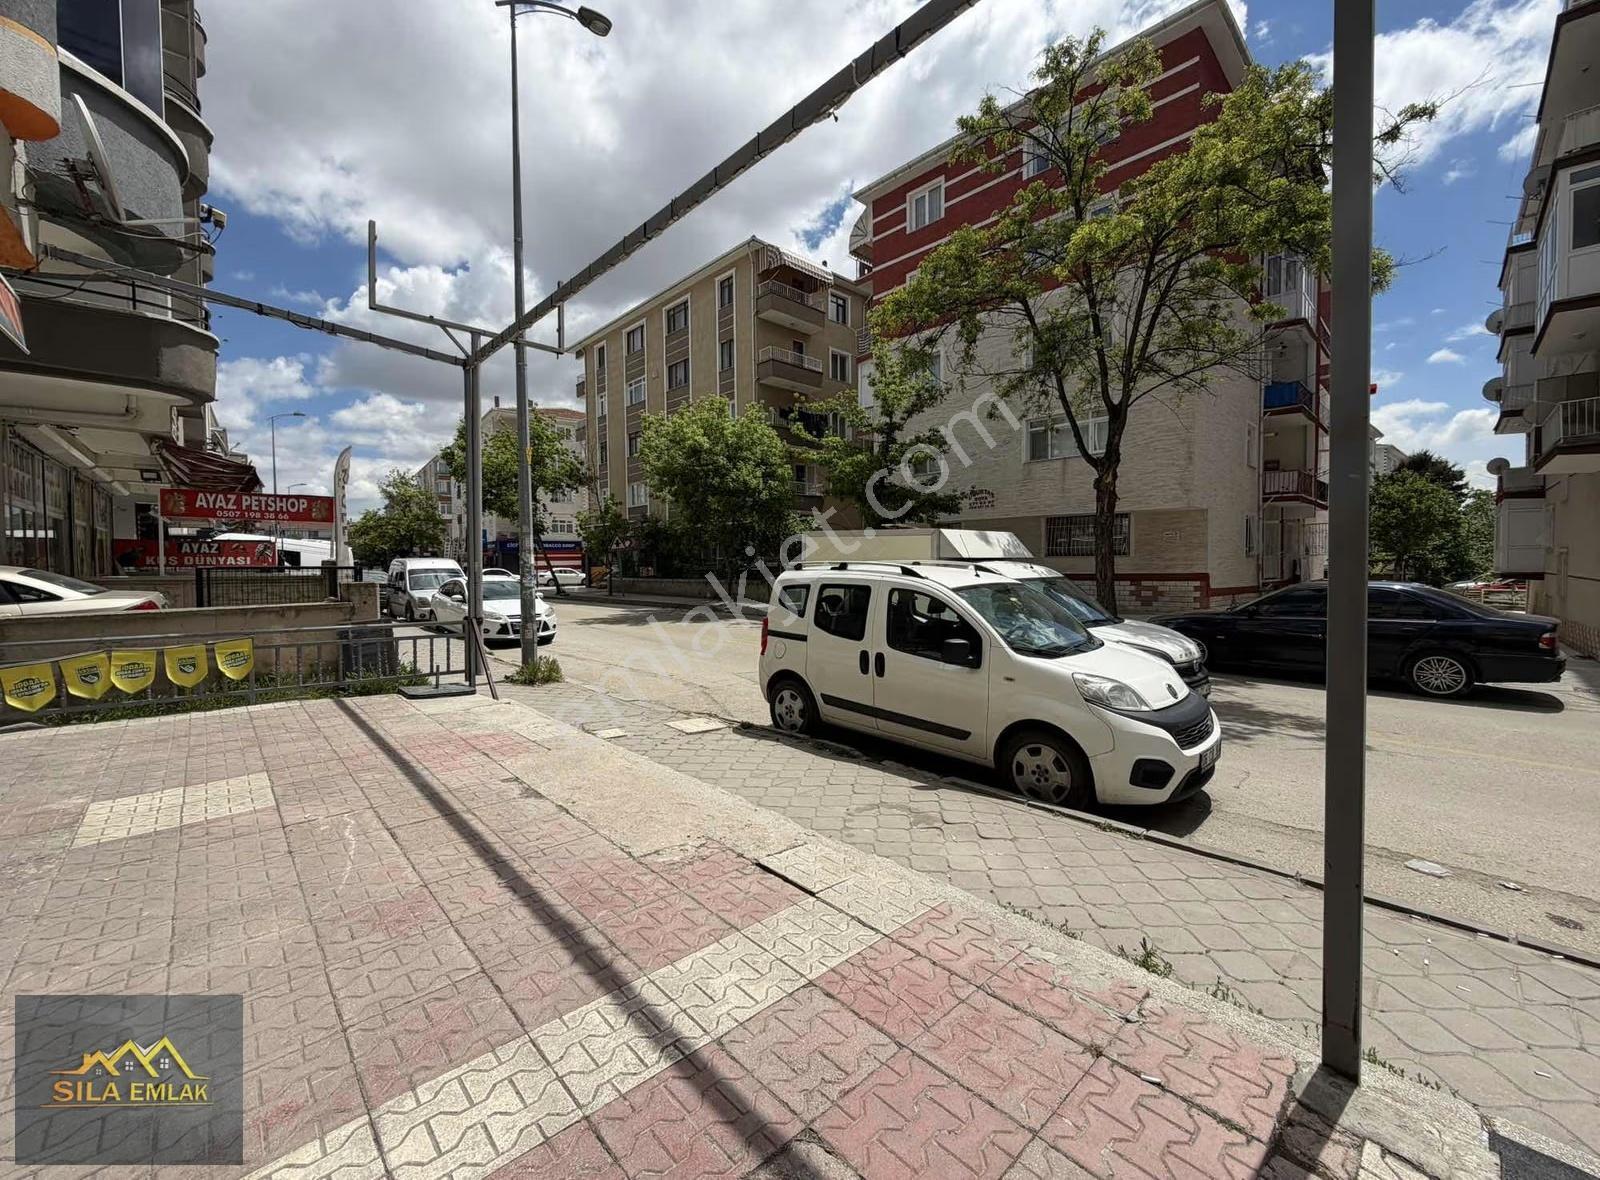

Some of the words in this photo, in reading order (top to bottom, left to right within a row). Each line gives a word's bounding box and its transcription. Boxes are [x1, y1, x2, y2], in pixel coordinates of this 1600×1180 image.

[195, 492, 238, 510] AYAZ
[242, 494, 308, 512] PETSHOP
[216, 510, 241, 518] 0507
[181, 542, 219, 554] AYAZ
[184, 554, 251, 565] DÜNYASI
